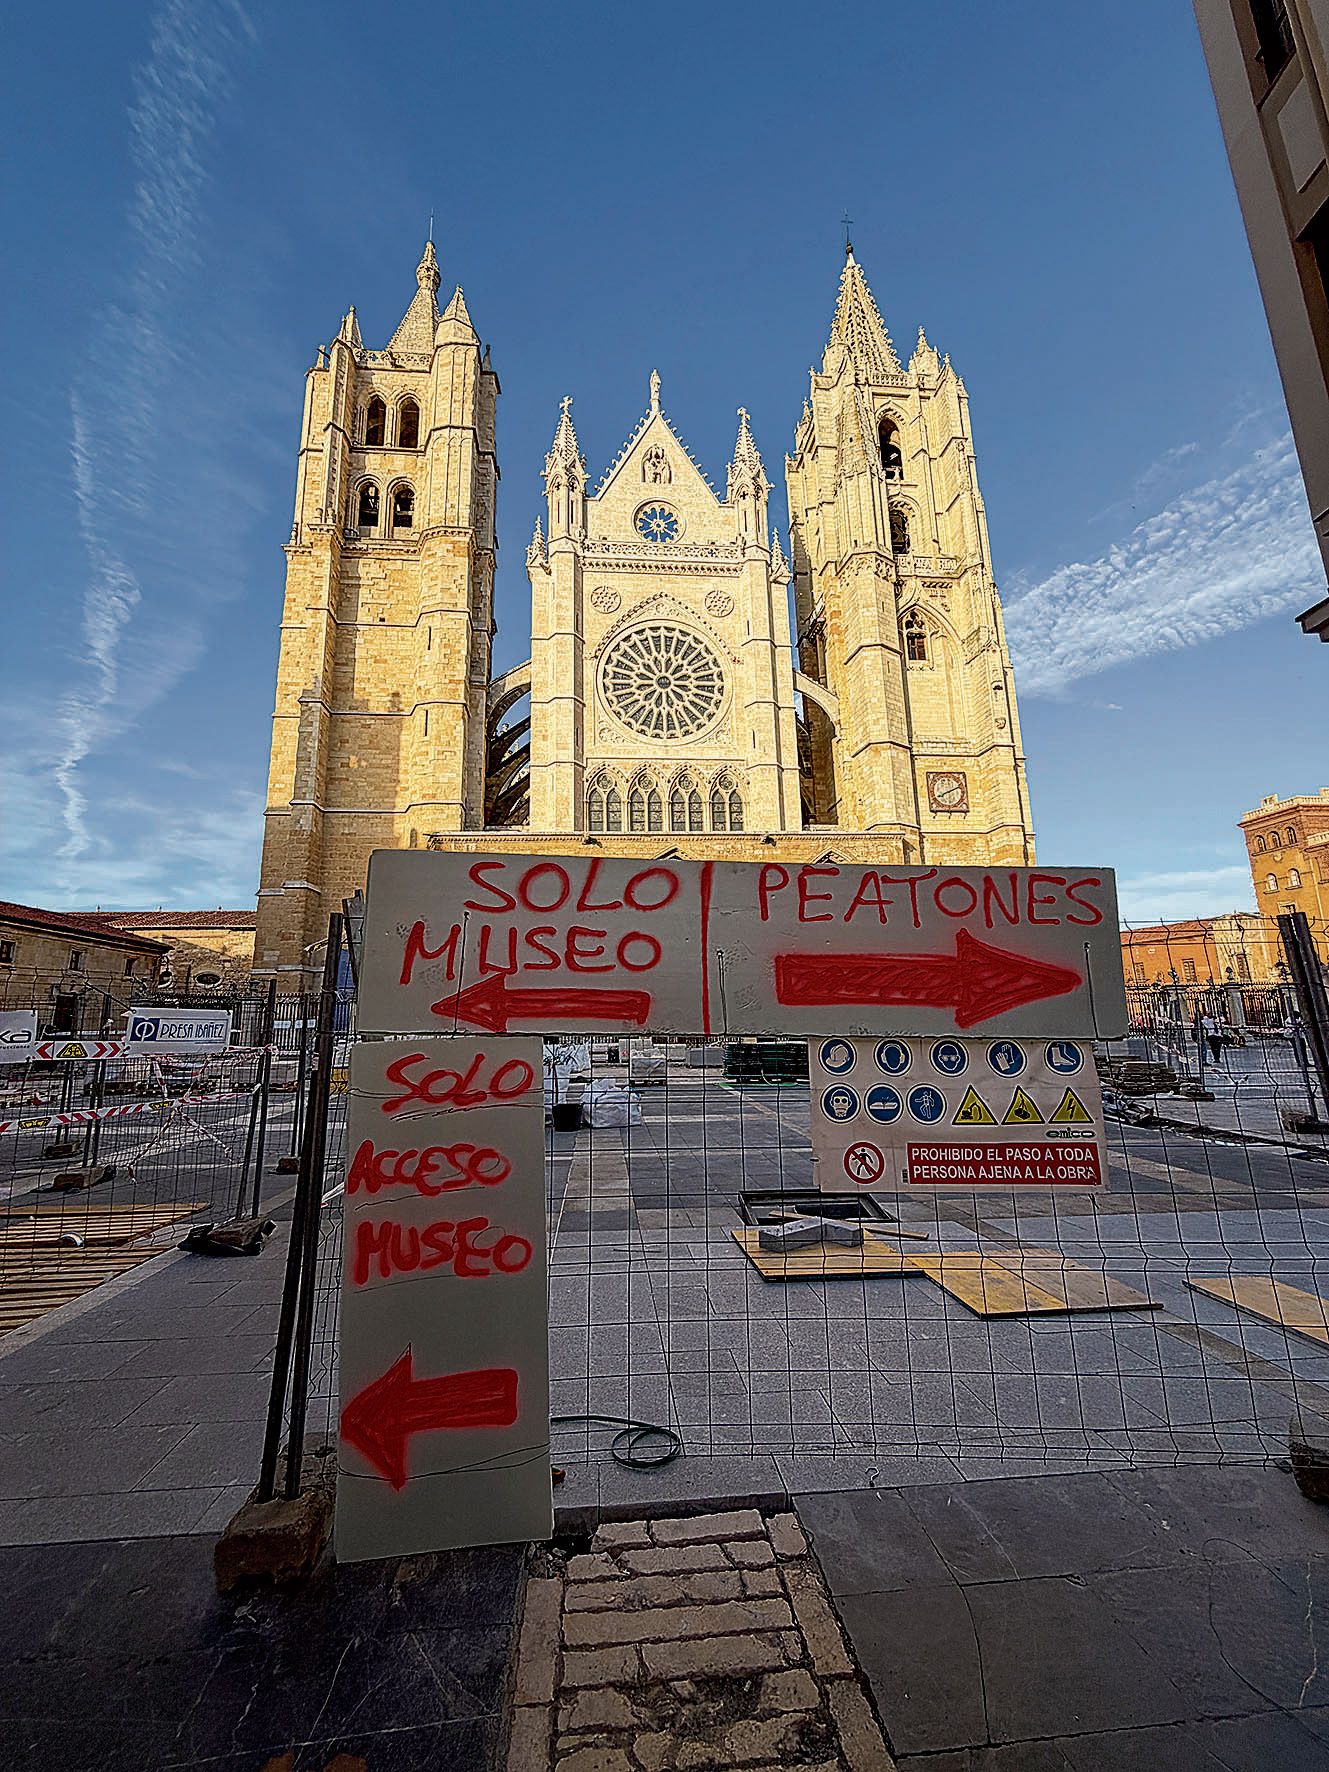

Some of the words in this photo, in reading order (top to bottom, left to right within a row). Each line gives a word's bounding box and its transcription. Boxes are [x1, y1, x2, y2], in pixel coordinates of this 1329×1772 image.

[465, 858, 681, 914] SOLO
[757, 864, 1103, 930] PEATONES
[398, 920, 663, 985] MUSEO
[160, 1023, 193, 1039] PRESA
[195, 1021, 225, 1038] IBAÑEZ
[382, 1053, 535, 1113] SOLO
[347, 1139, 513, 1198] ACCESO
[912, 1148, 983, 1161] PROHIBIDO
[987, 1148, 1003, 1161] EL
[1006, 1148, 1041, 1161] PASO
[1044, 1148, 1054, 1161] A
[1056, 1148, 1095, 1161] TODA
[913, 1165, 976, 1179] PERSONA
[979, 1165, 1022, 1179] AJENA
[1024, 1165, 1034, 1179] A
[1036, 1165, 1055, 1179] LA
[1056, 1166, 1097, 1179] OBRA
[354, 1216, 534, 1287] MUSEO
